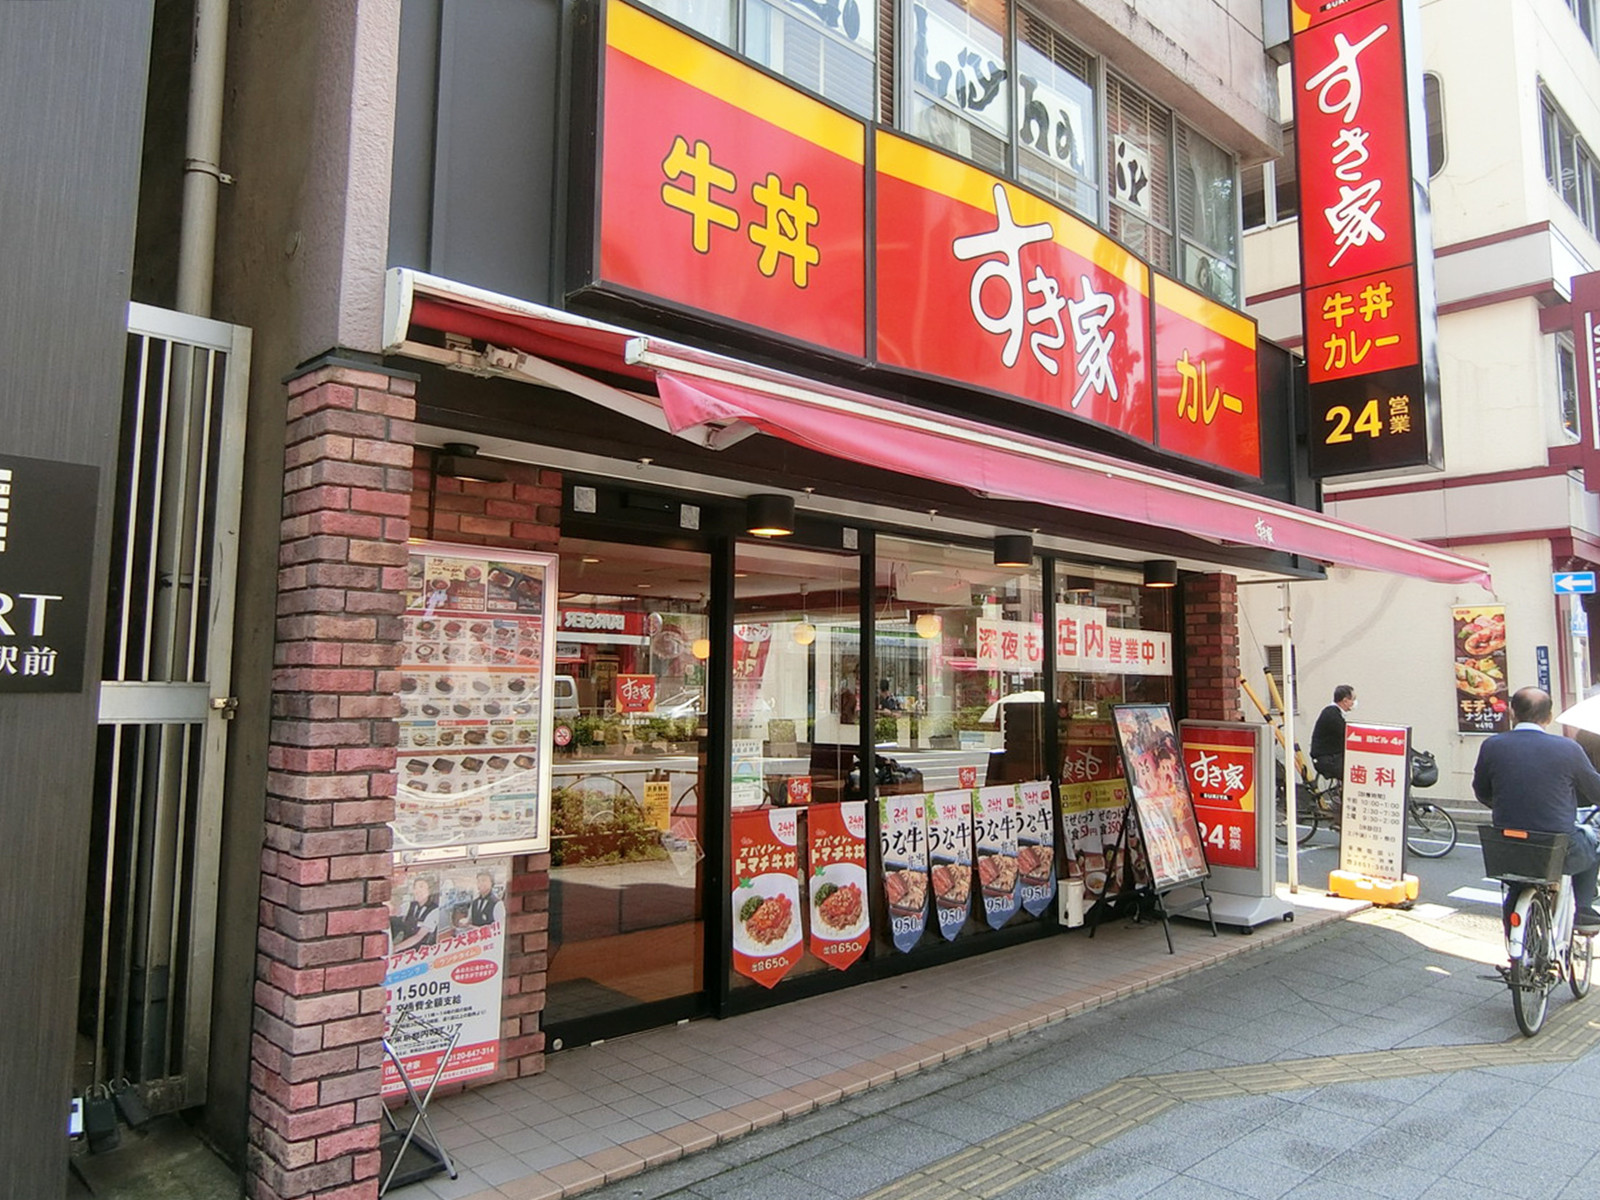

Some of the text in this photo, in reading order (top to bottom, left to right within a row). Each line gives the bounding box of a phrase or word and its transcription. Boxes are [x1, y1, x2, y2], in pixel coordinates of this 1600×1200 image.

[1304, 23, 1389, 268] すき家
[661, 135, 820, 289] 牛丼
[952, 184, 1120, 409] すき家
[1322, 282, 1394, 329] 牛丼
[1323, 331, 1400, 372] カレー
[1177, 348, 1244, 426] カレー
[1325, 394, 1411, 445] 24 営業
[978, 627, 1043, 662] 深夜も
[621, 678, 651, 701] すき家
[1190, 750, 1245, 794] すき家
[1350, 764, 1396, 789] 歯科
[988, 798, 1002, 808] 24H
[778, 822, 795, 832] 24H
[848, 815, 864, 825] 24H
[975, 815, 1016, 843] うな牛
[1016, 808, 1053, 834] うな牛
[740, 843, 782, 858] スパイシー
[814, 835, 852, 848] スパイシー
[881, 826, 924, 857] うな牛
[929, 823, 971, 852] うな牛
[1229, 826, 1242, 851] 営業
[735, 851, 796, 876] トマチ牛丼
[811, 843, 866, 865] トマチ牛丼
[396, 981, 451, 1001] 1,500円
